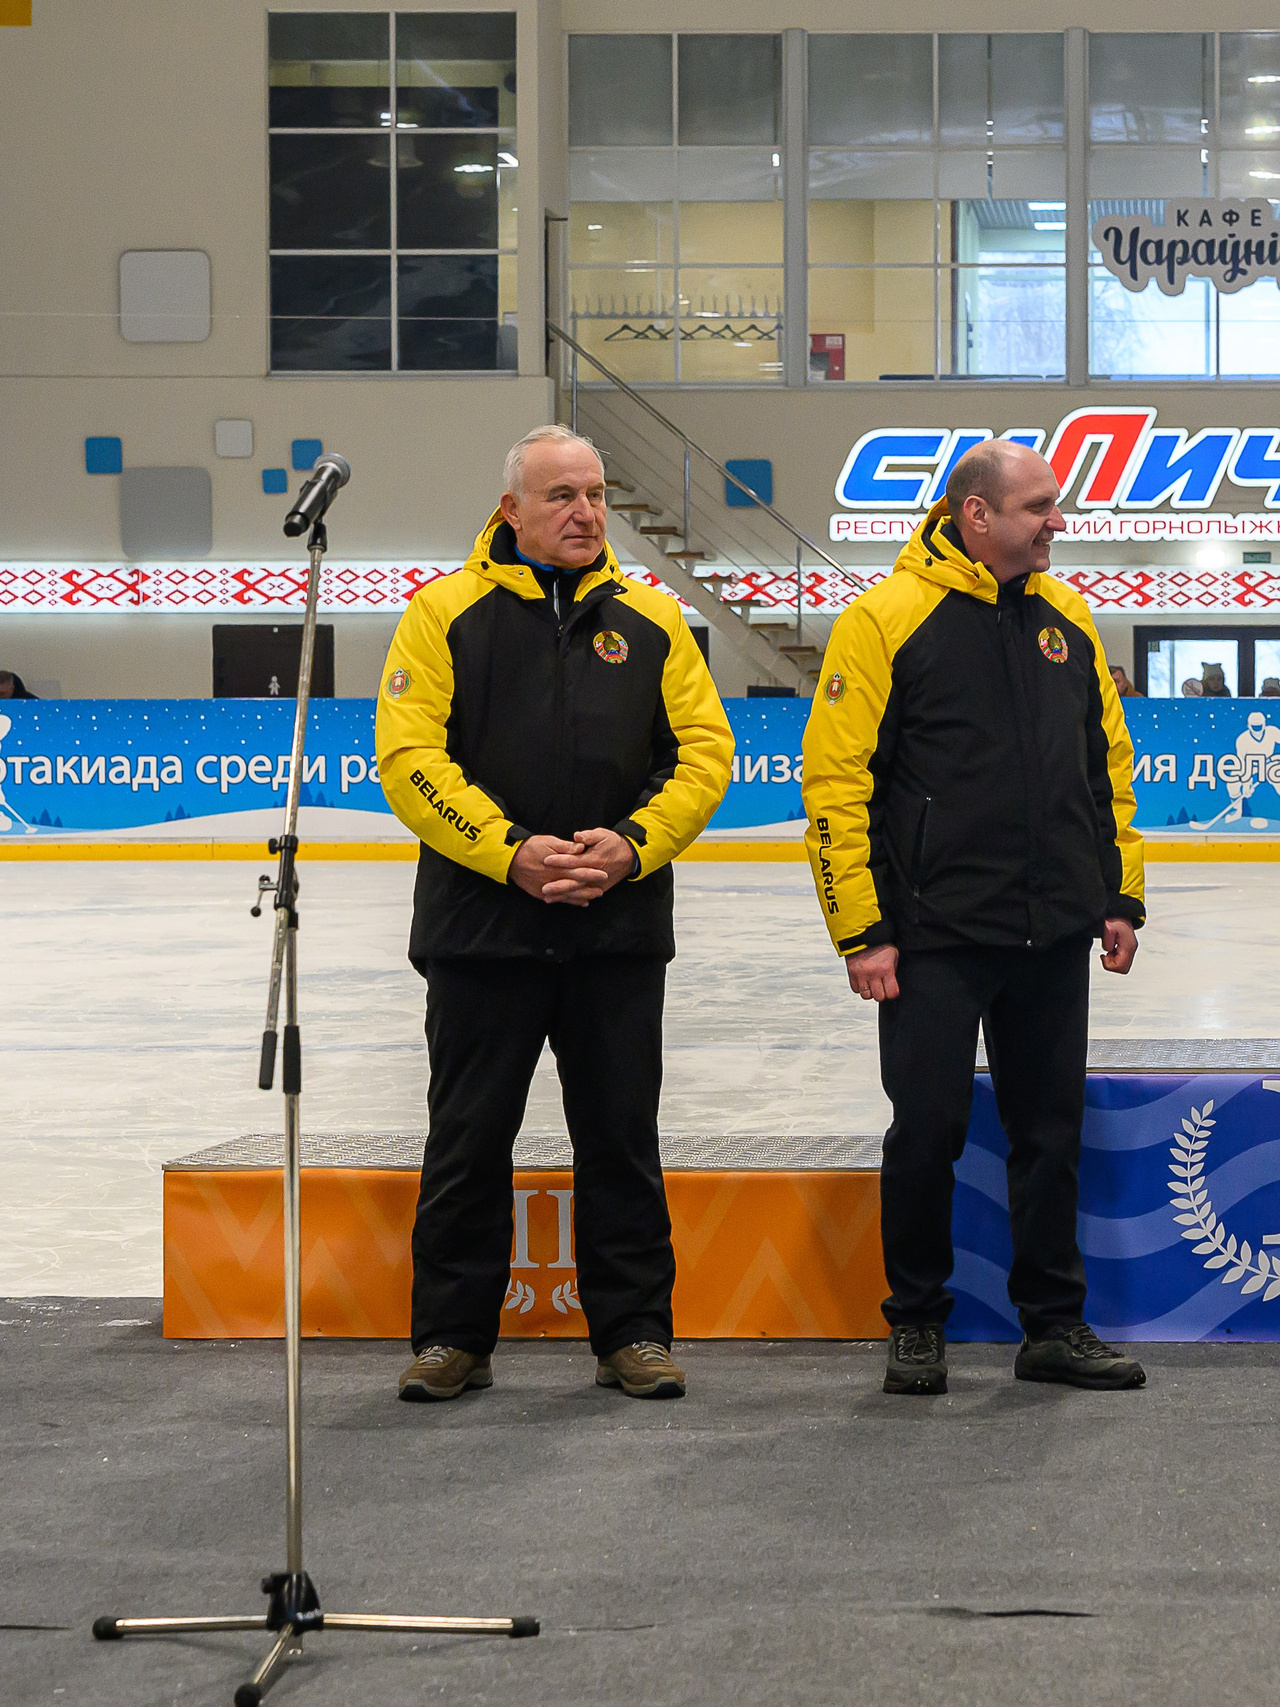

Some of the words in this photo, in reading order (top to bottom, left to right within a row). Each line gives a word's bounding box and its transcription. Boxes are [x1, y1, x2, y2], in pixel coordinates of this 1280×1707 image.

[1176, 208, 1262, 227] КАФЕ
[1064, 515, 1112, 535] ИЙ
[0, 754, 183, 792] такиада
[196, 754, 326, 794] среди
[409, 769, 482, 842] BELARUS
[816, 817, 839, 915] BELARUS
